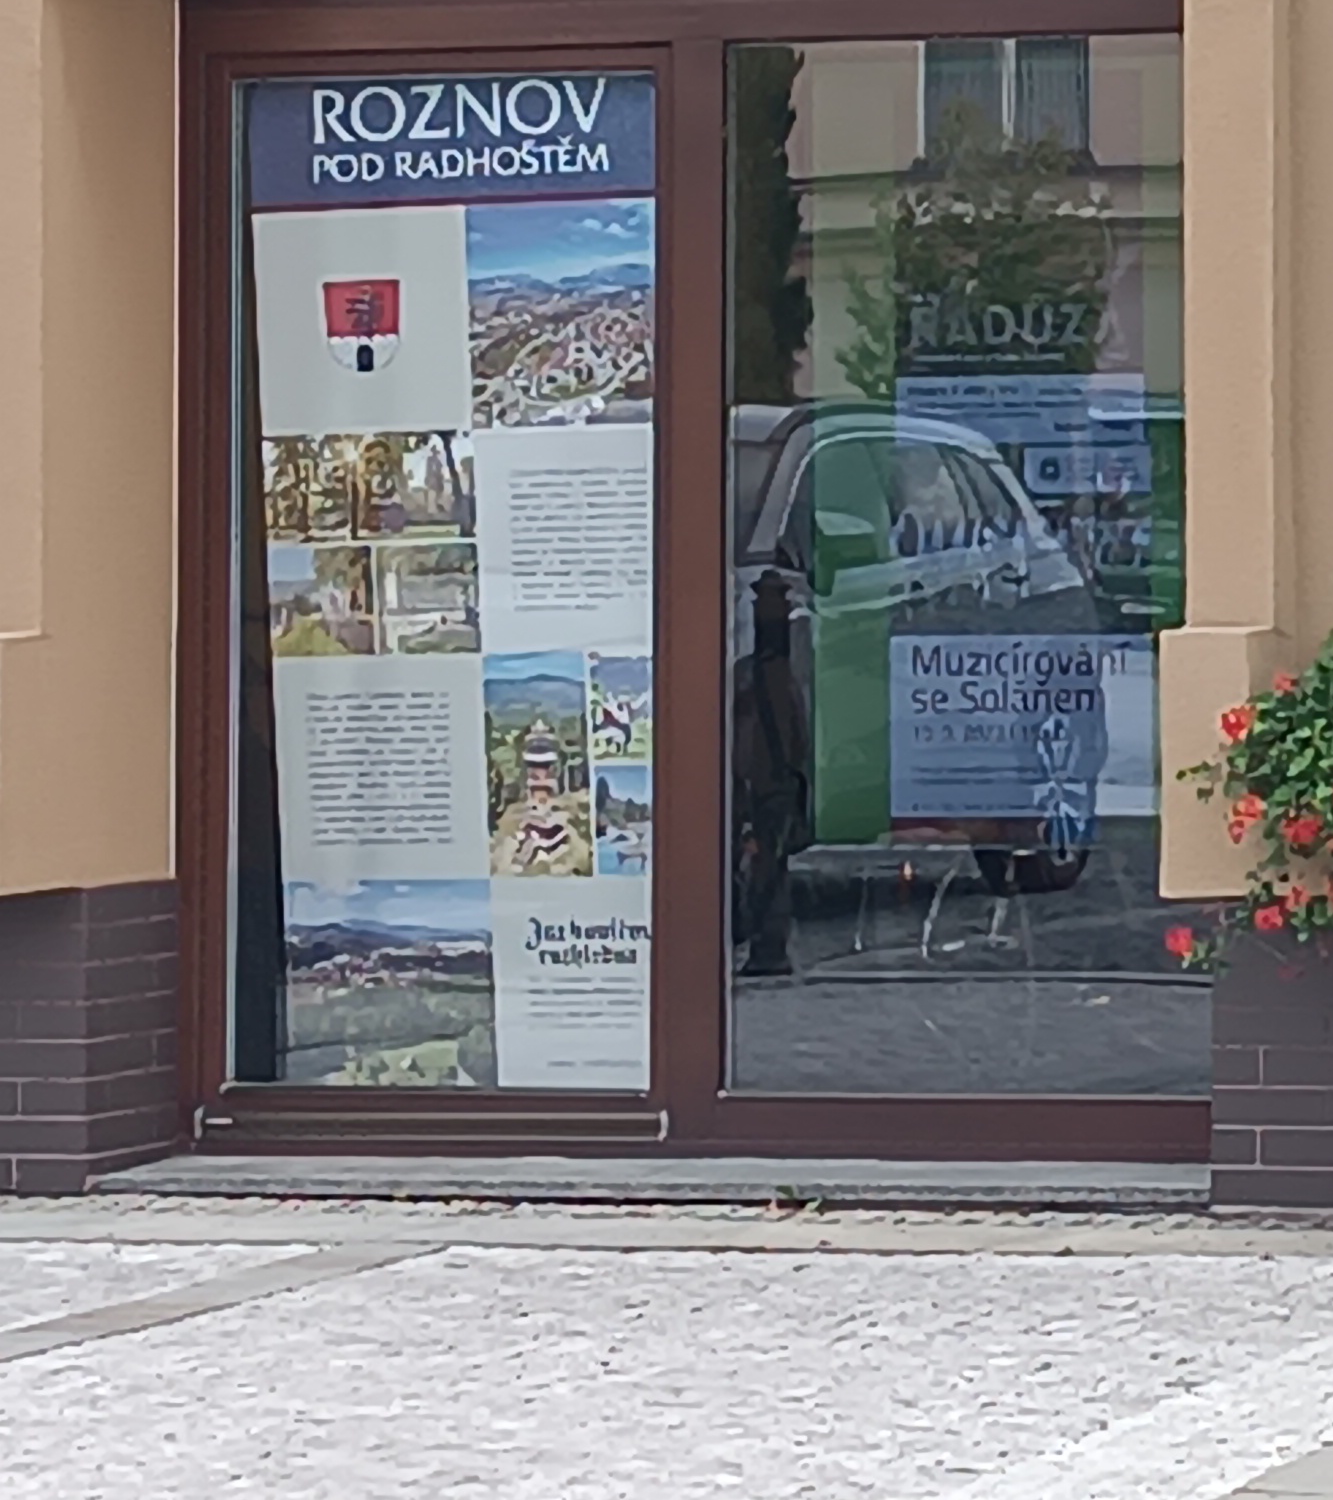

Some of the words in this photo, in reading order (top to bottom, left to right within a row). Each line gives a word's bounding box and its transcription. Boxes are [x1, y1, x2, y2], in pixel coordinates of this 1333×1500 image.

[312, 153, 385, 184] POD
[395, 133, 610, 178] RADHOŠTĚM
[911, 687, 949, 715] se
